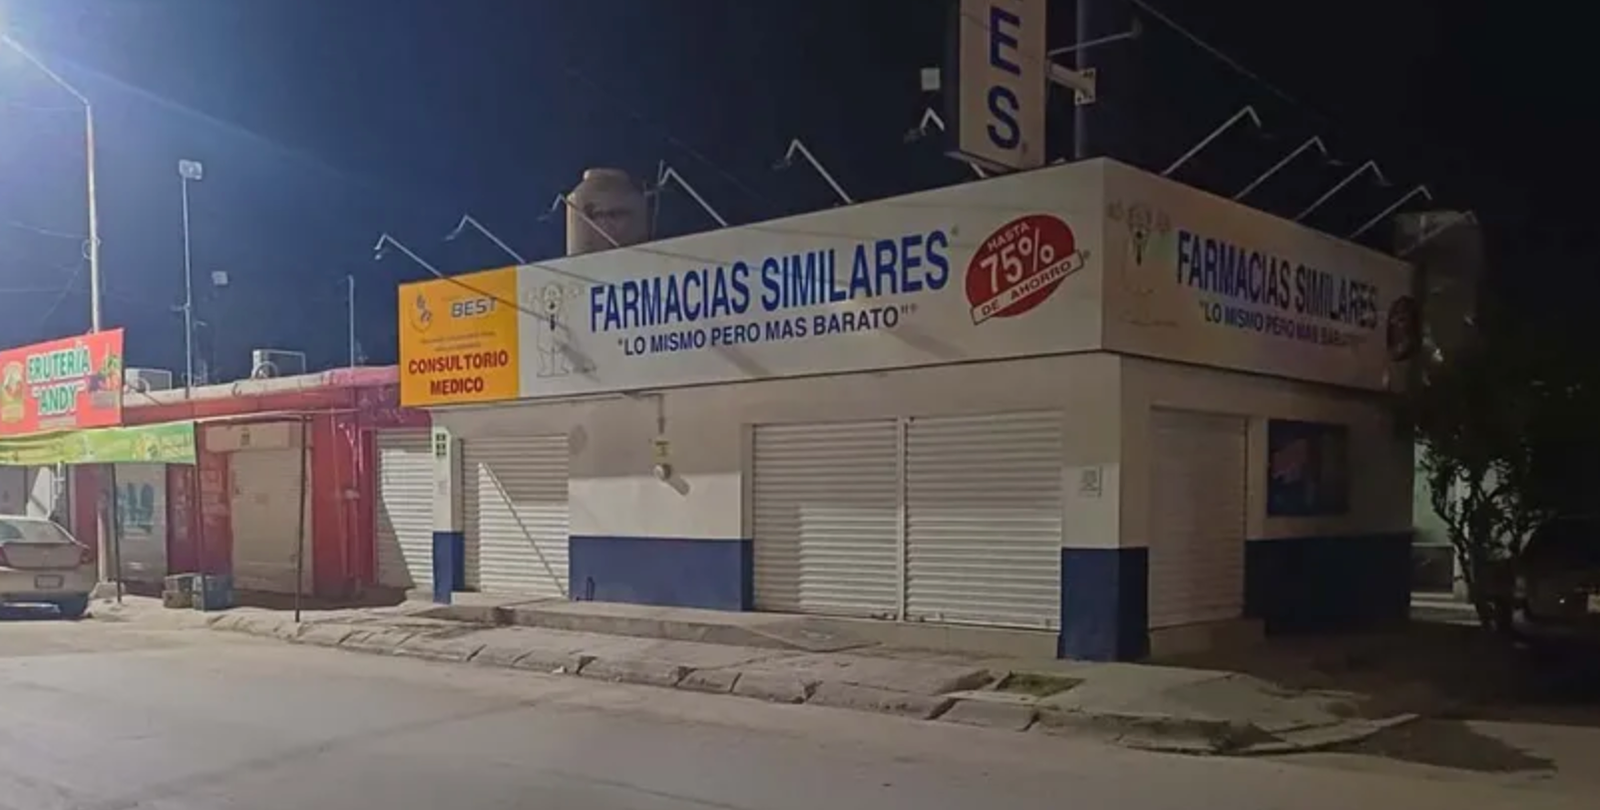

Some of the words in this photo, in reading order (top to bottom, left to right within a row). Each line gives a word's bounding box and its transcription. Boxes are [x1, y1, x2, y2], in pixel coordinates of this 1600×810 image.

[987, 0, 1022, 150] ES
[987, 222, 1030, 252] HASTA
[980, 227, 1054, 294] 75%
[590, 261, 750, 333] FARMACIAS
[761, 230, 949, 311] SIMILARES
[981, 299, 1000, 316] DE
[1011, 261, 1071, 301] AHORRO
[1177, 230, 1291, 310] FARMACIAS
[1295, 264, 1377, 329] SIMILARES
[450, 297, 497, 319] BEST
[1224, 305, 1264, 333] MISMO
[651, 329, 706, 353] MISMO
[711, 322, 761, 347] PERO
[765, 316, 807, 341] MAS
[408, 350, 508, 375] CONSULTORIO
[430, 376, 484, 396] MEDICO
